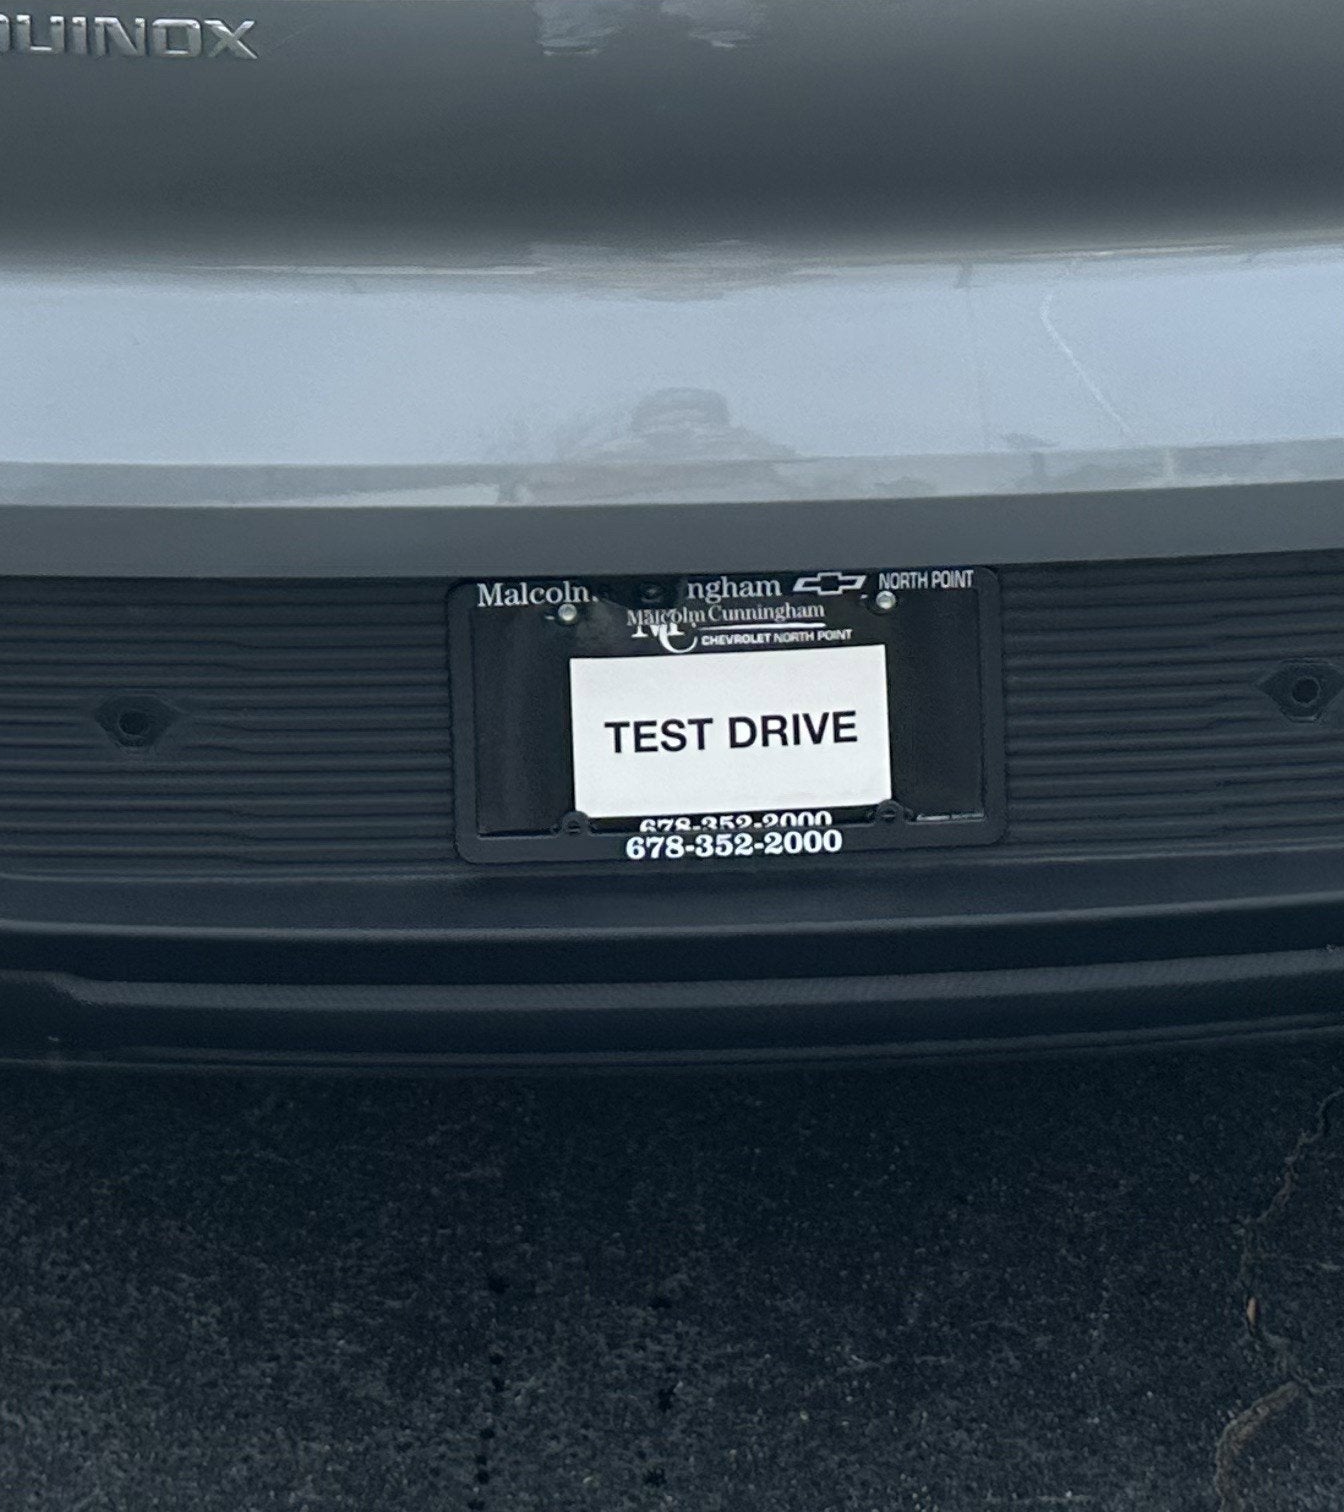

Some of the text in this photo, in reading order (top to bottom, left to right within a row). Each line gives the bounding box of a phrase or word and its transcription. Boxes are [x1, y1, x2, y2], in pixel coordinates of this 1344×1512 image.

[878, 570, 974, 590] NORTH POINT
[626, 602, 826, 626] Malcolm Cunningham
[701, 628, 854, 646] CHEVROLET NORTH POINT
[604, 710, 858, 754] TEST DRIVE
[625, 829, 844, 860] 678-352-2000
